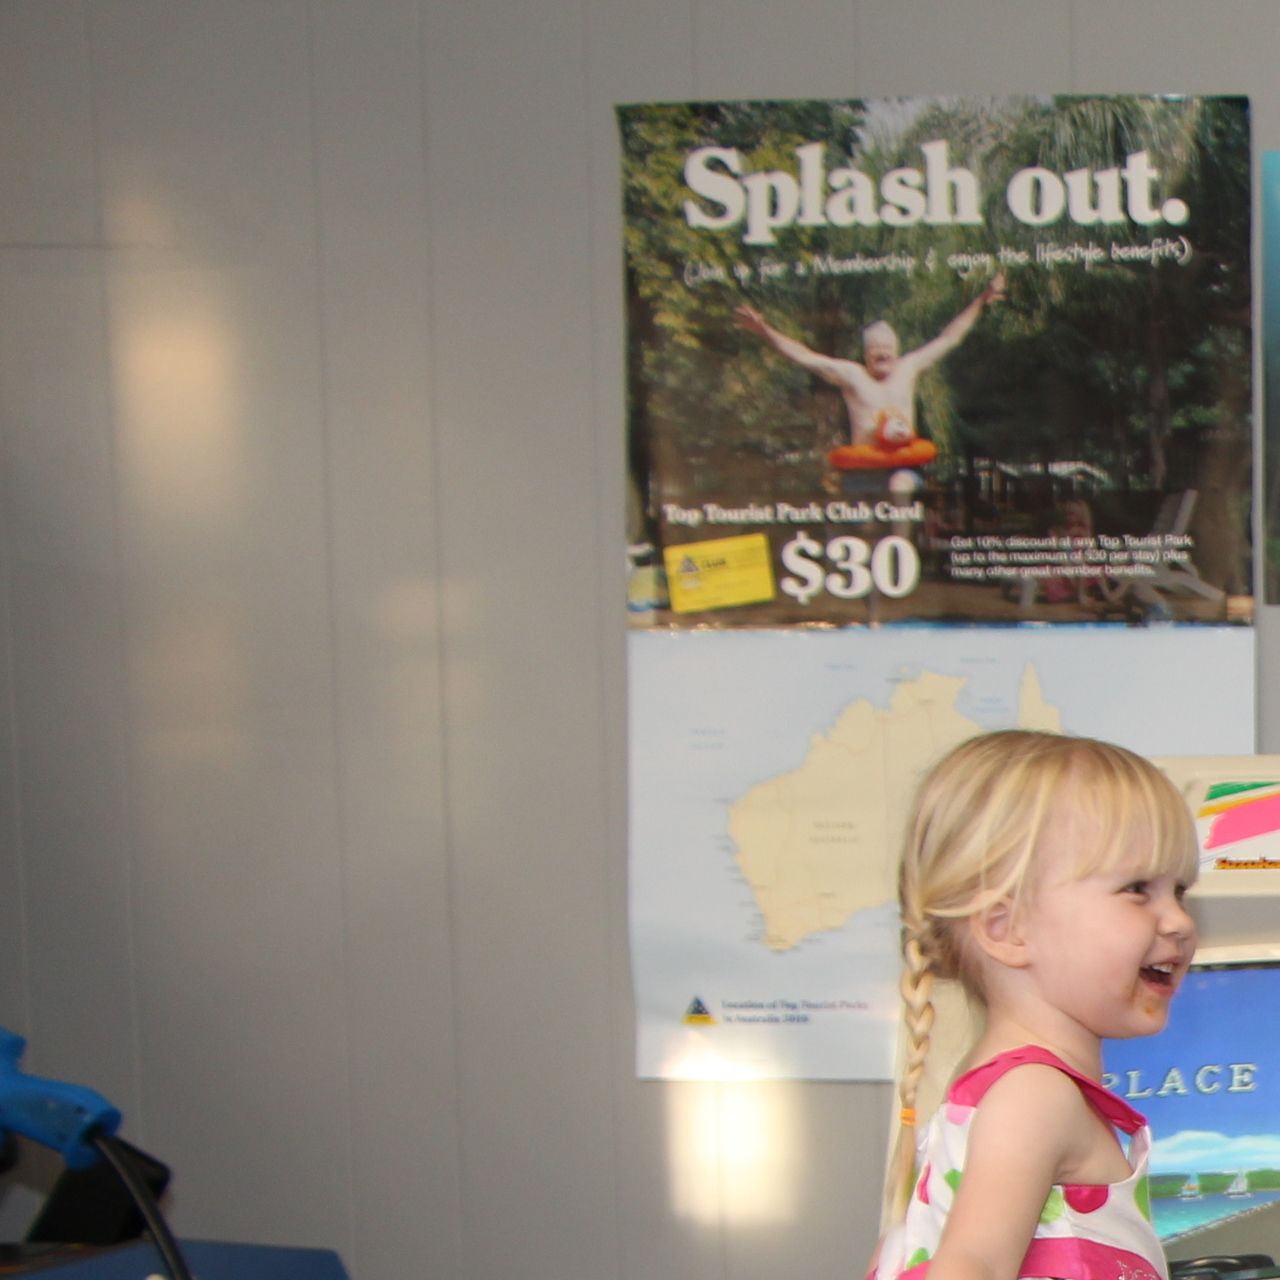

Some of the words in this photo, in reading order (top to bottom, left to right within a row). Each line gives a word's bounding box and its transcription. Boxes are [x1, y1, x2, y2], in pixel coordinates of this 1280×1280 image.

[684, 139, 984, 244] Splash
[1006, 150, 1190, 226] out.
[662, 503, 701, 527] Top
[703, 502, 774, 523] Tourist
[776, 502, 825, 522] Park
[826, 501, 873, 522] Club
[875, 501, 925, 522] Card
[1005, 535, 1056, 548] discount
[1098, 535, 1119, 550] Top
[1122, 535, 1161, 547] Tourist
[1164, 534, 1194, 547] Park
[781, 530, 921, 605] $30
[1009, 550, 1067, 562] maximum
